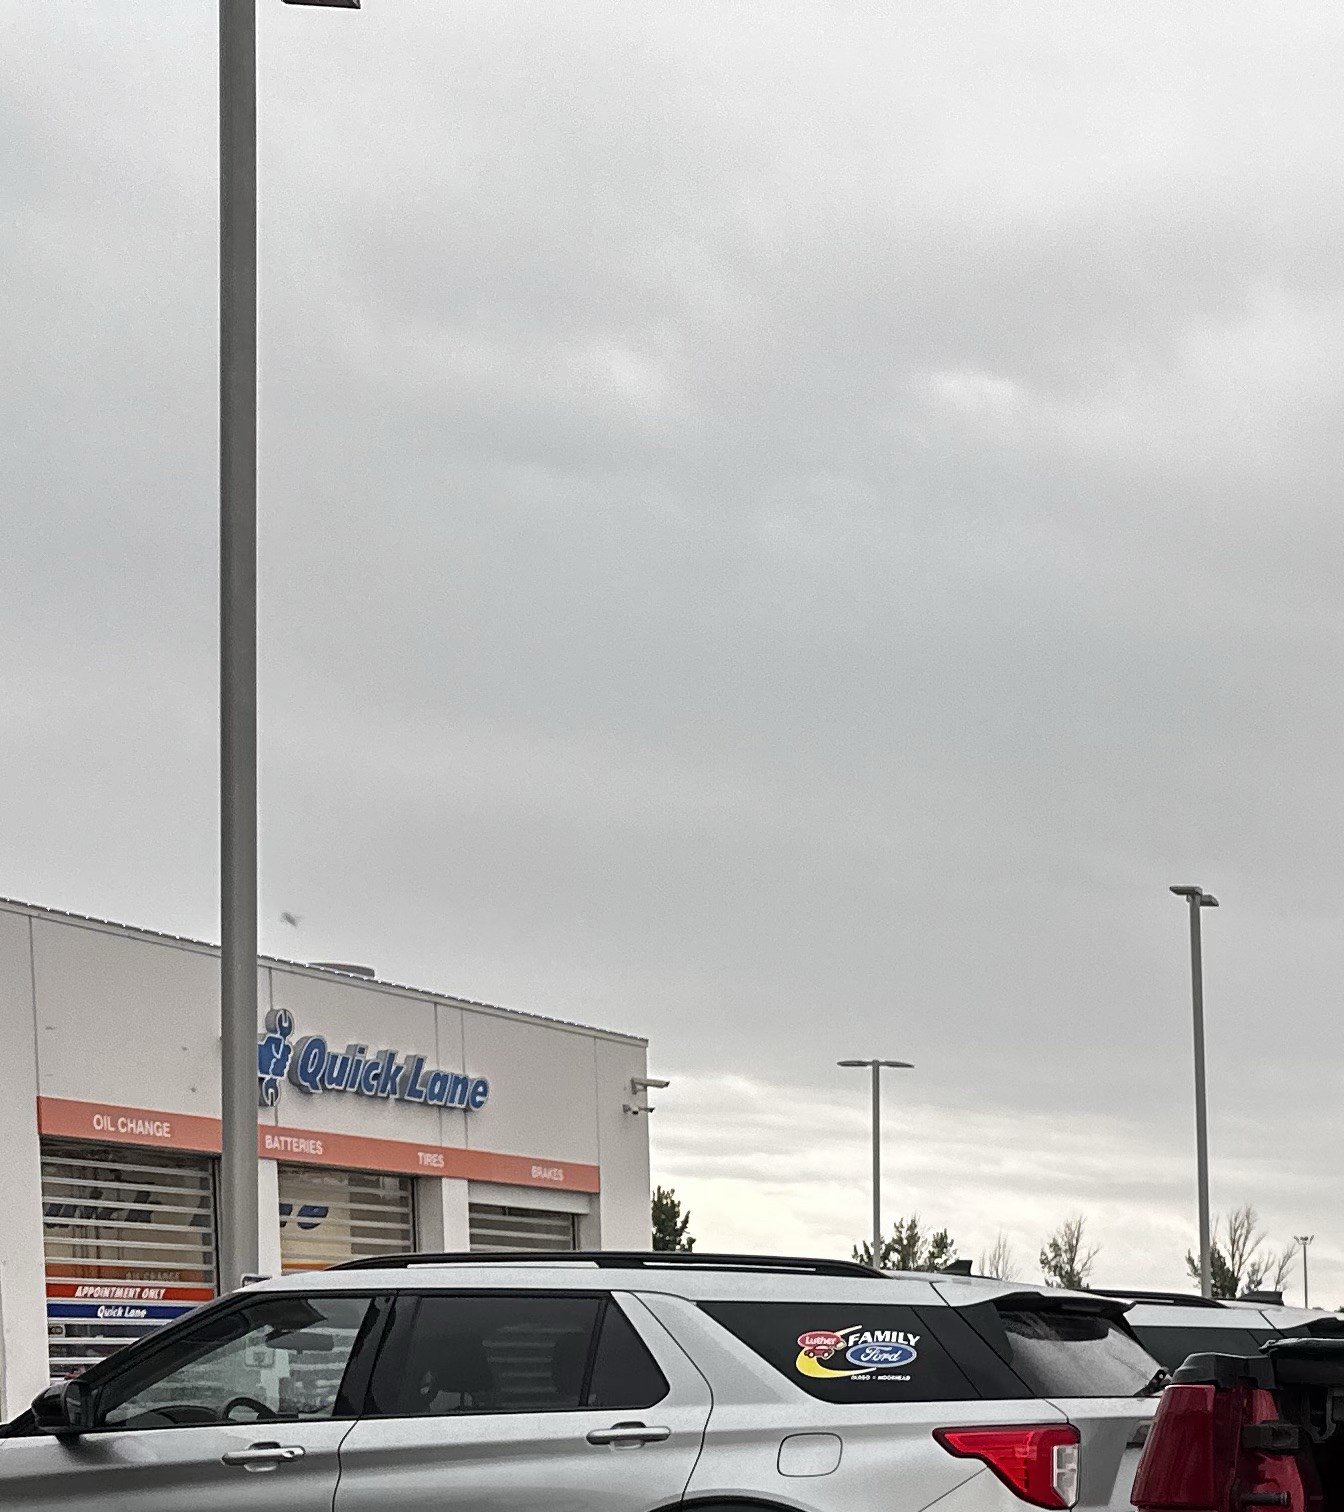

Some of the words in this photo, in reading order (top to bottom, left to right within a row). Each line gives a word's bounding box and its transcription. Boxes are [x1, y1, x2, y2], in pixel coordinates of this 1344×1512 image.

[296, 1034, 404, 1098] Quick
[404, 1054, 490, 1112] Lane
[92, 1113, 115, 1132] OIL
[117, 1116, 172, 1138] CHANGE
[264, 1134, 323, 1155] BATTERIES
[417, 1151, 445, 1168] TIRES
[531, 1165, 565, 1182] BRAKES
[74, 1285, 140, 1299] APPOINTMENT
[141, 1287, 167, 1300] ONLY
[96, 1305, 124, 1319] Quick
[124, 1306, 147, 1319] Lane
[805, 1336, 837, 1346] Luther
[847, 1330, 921, 1347] FAMILY
[860, 1345, 902, 1362] Ford
